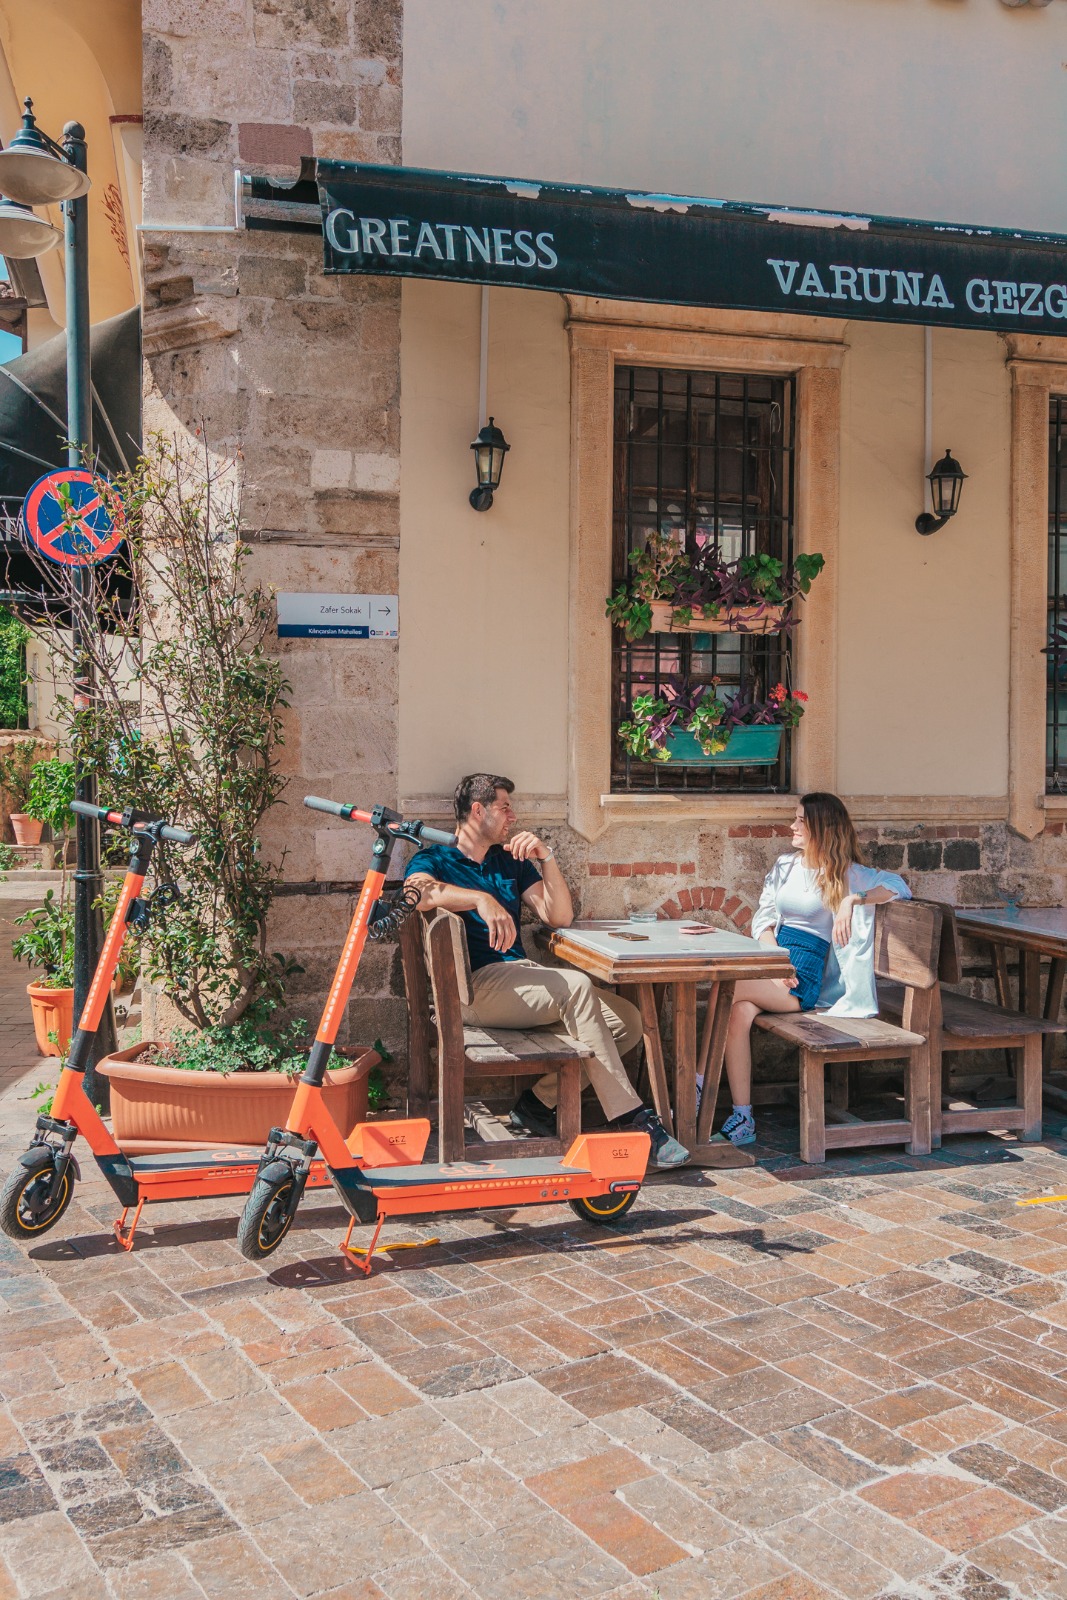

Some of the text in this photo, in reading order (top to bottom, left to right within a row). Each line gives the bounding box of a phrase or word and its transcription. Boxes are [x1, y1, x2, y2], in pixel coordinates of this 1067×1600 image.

[325, 207, 558, 270] GREATNESS
[766, 258, 955, 310] VARUNA
[320, 605, 361, 614] Zafer Sokak
[388, 1135, 407, 1144] GEZ
[612, 1148, 629, 1157] GEZ
[439, 1163, 505, 1174] GEZ
